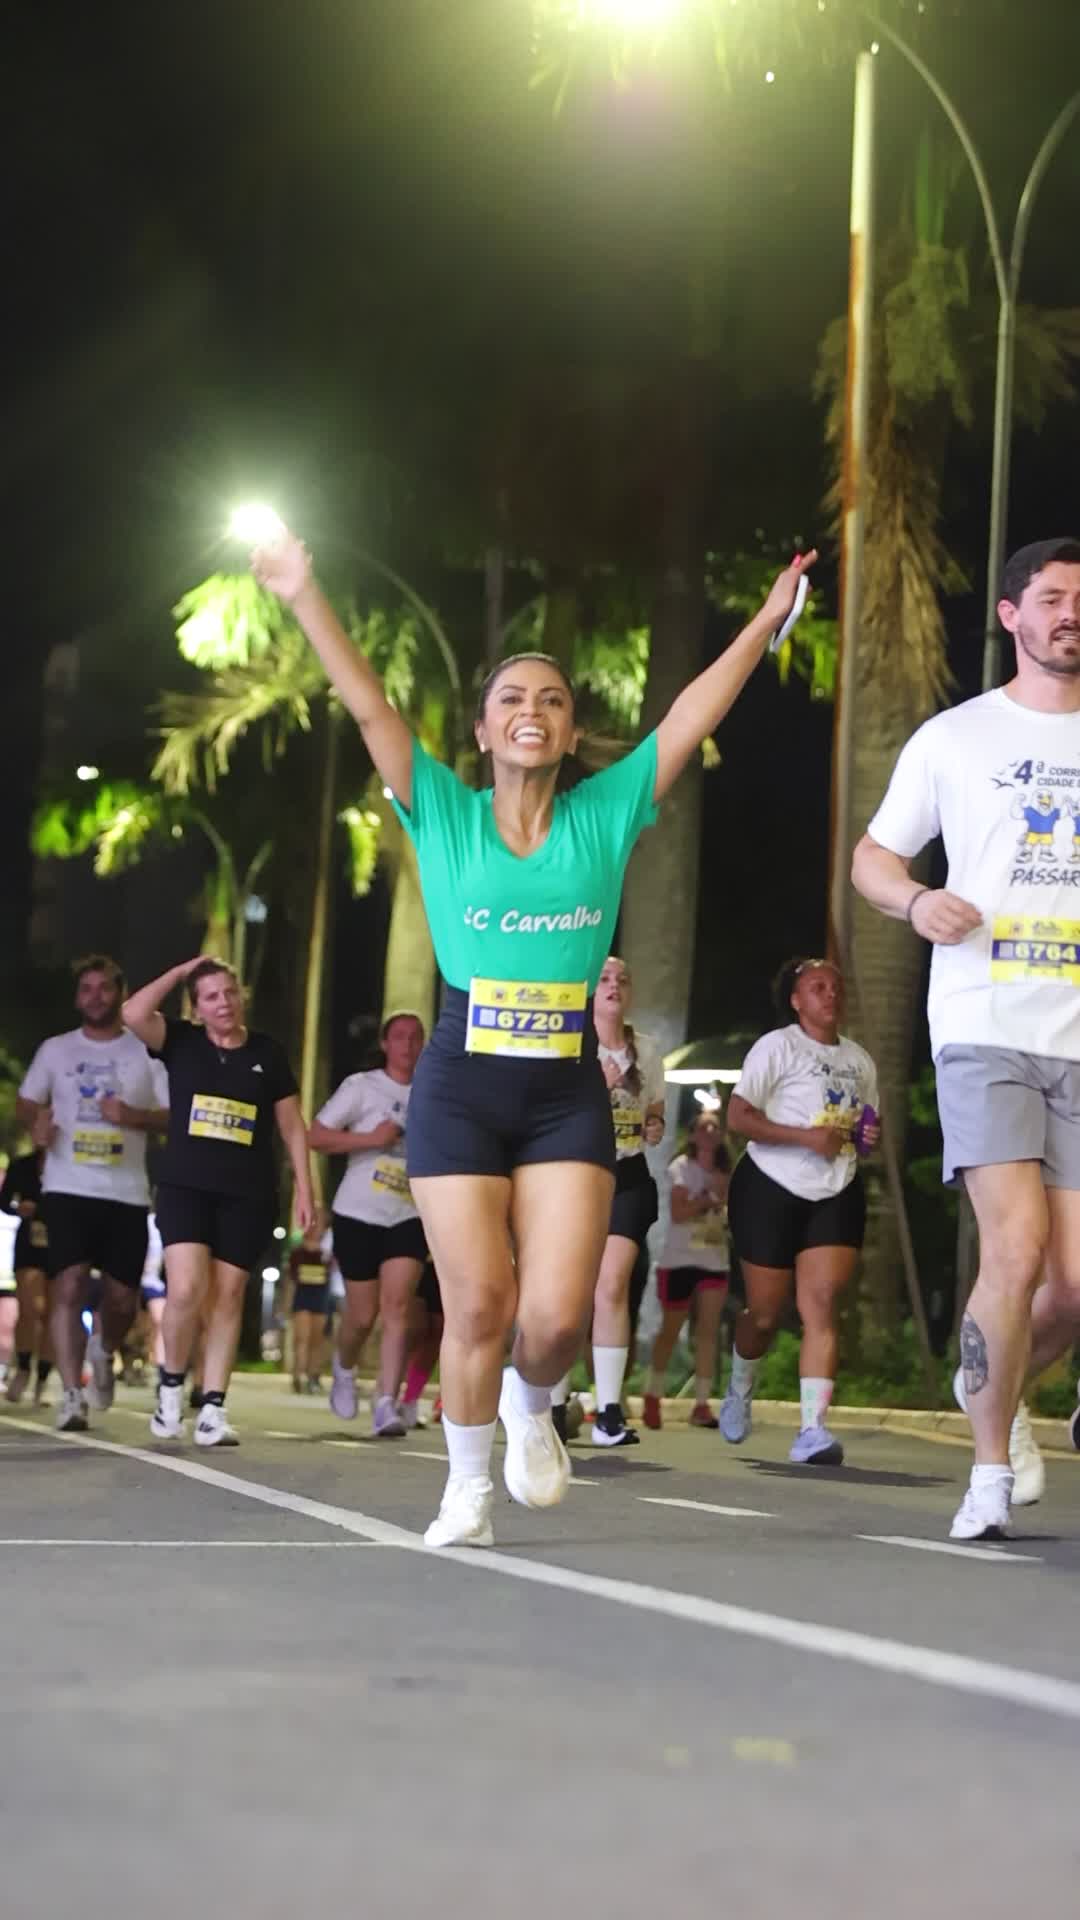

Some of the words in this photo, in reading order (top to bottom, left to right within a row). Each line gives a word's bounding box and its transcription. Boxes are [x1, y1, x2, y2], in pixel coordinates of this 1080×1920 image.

[1036, 777, 1075, 788] CIDADE
[500, 904, 603, 933] Carvalho
[1015, 942, 1077, 961] 6764
[497, 1010, 564, 1031] 6720
